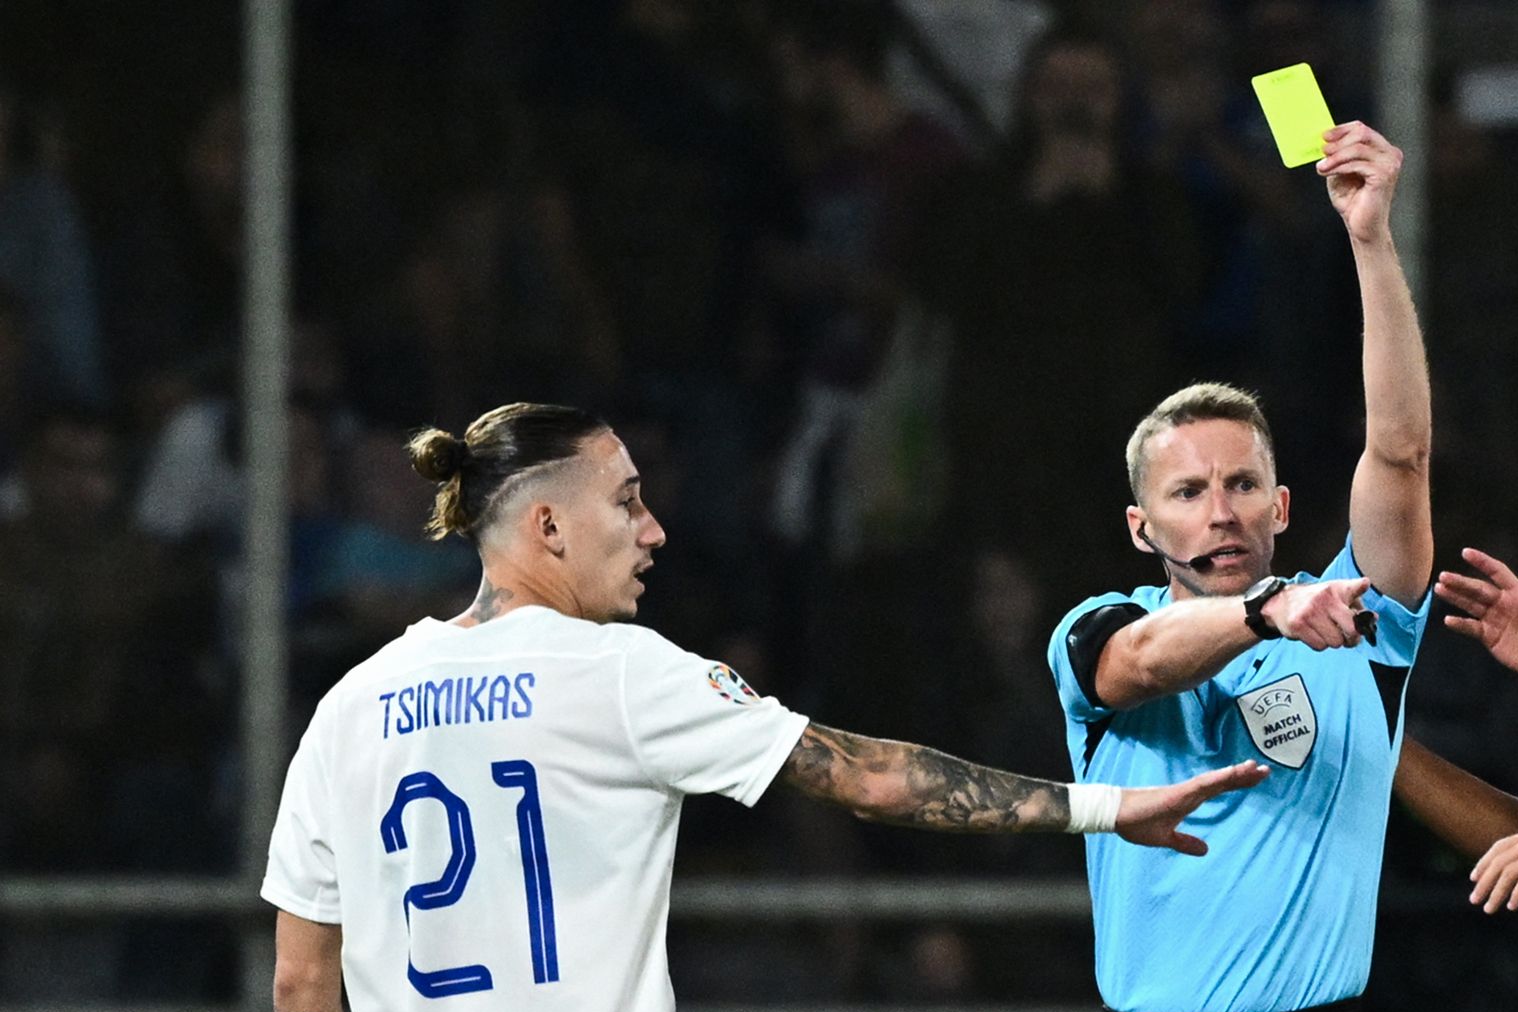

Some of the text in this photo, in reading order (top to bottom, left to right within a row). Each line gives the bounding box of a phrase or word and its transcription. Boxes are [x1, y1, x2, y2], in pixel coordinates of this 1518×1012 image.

[379, 672, 535, 740] TSIMIKAS
[1254, 692, 1293, 715] UEFA
[1263, 713, 1302, 736] MATCH
[1263, 725, 1311, 749] OFFICIAL
[380, 759, 559, 1000] 21
